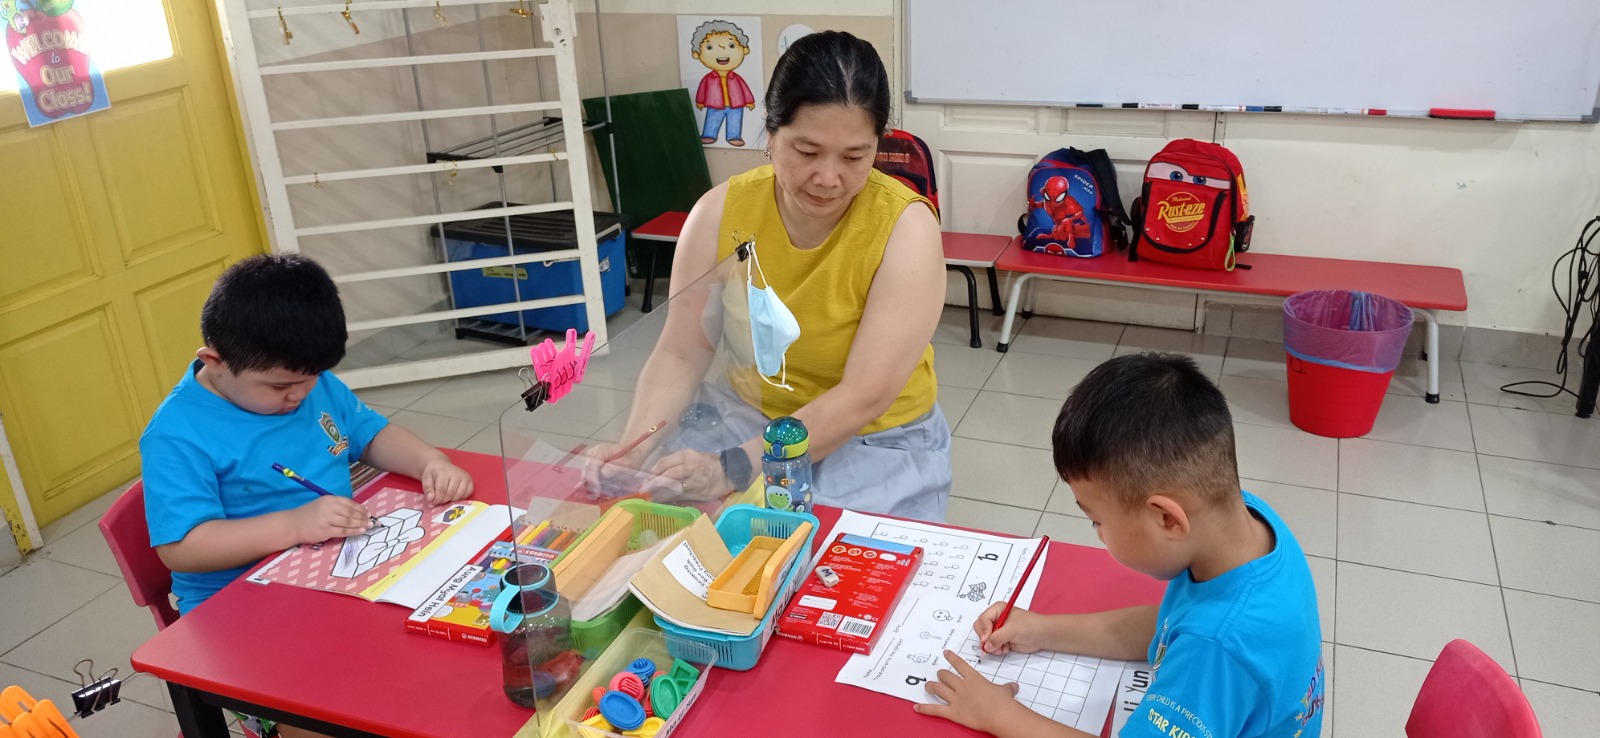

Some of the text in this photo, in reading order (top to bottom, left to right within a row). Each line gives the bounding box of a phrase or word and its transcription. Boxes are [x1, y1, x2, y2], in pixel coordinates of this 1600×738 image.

[11, 29, 88, 65] WELCOM
[51, 51, 60, 63] to
[40, 65, 75, 87] Our
[38, 81, 92, 112] Class!
[1073, 174, 1094, 190] SPIDER
[525, 548, 556, 560] STABILO
[416, 565, 478, 619] Aung Myat Hein
[1125, 670, 1150, 694] Yun
[1147, 708, 1196, 738] STAR KID
[1156, 694, 1171, 706] CHILD
[1169, 701, 1177, 709] IS
[1175, 705, 1181, 713] A
[1180, 708, 1208, 734] PRECIOUS
